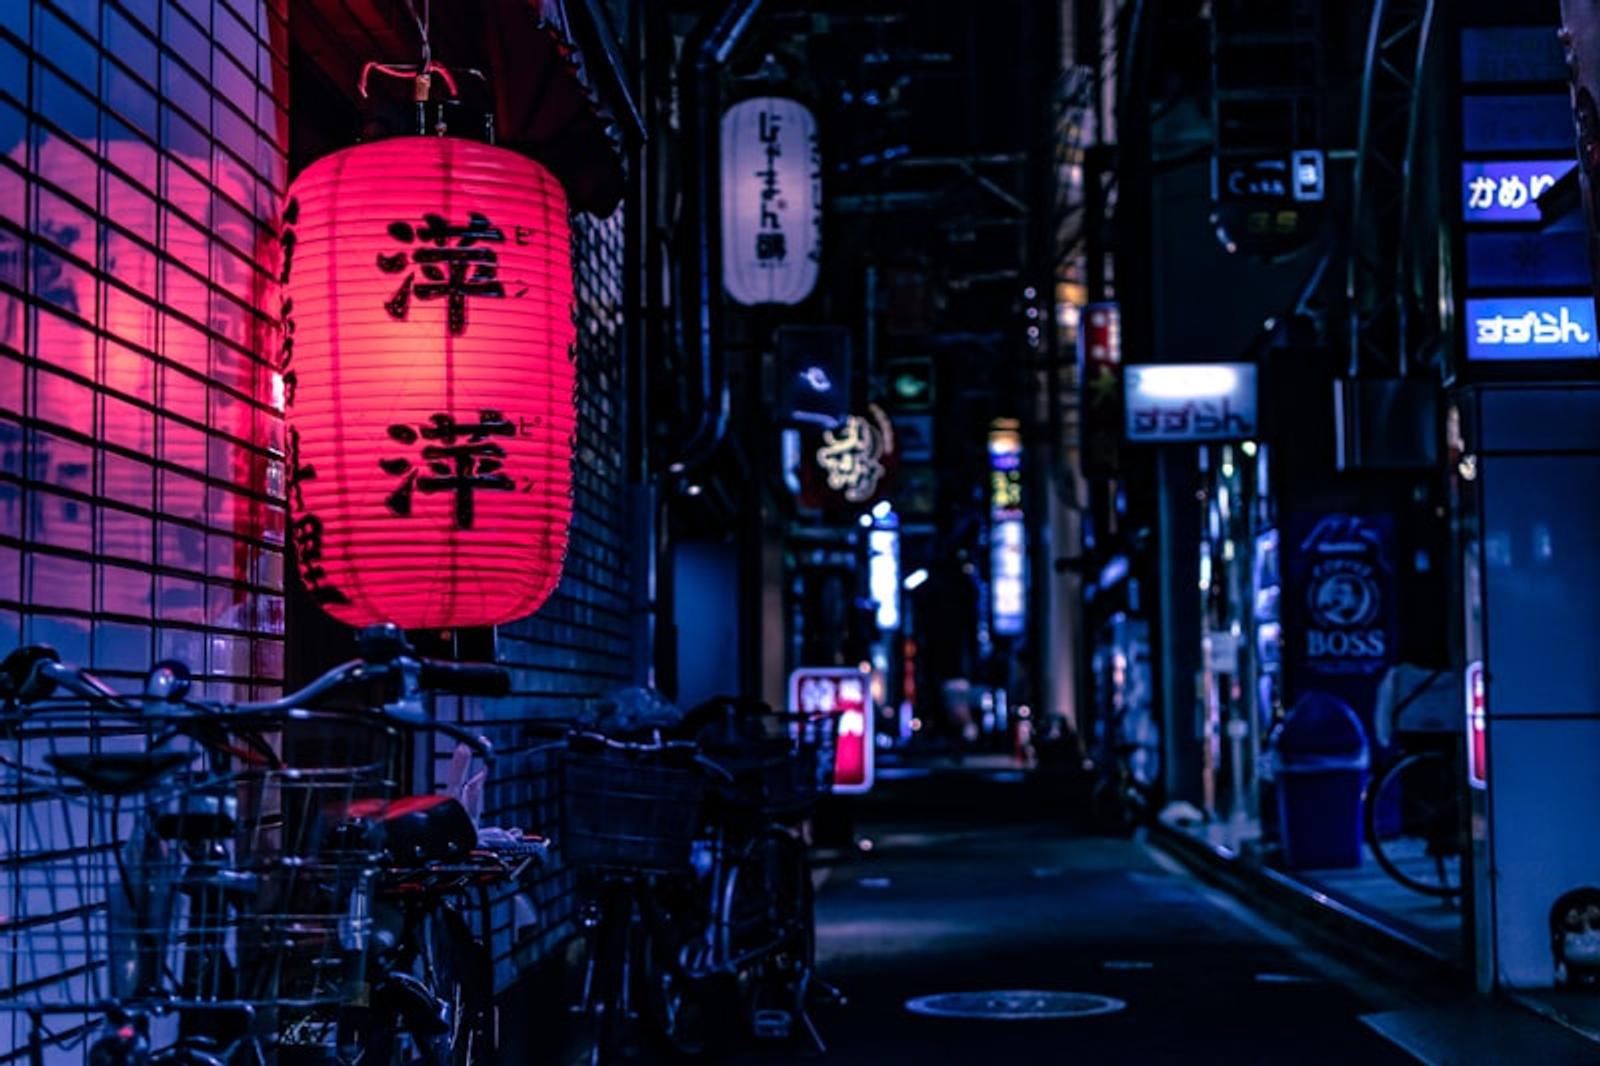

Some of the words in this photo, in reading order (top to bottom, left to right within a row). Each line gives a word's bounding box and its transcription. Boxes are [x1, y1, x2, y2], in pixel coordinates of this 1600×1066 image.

[1475, 306, 1590, 345] すずらん
[1135, 397, 1253, 434] すずらん
[1304, 628, 1387, 657] BOSS
